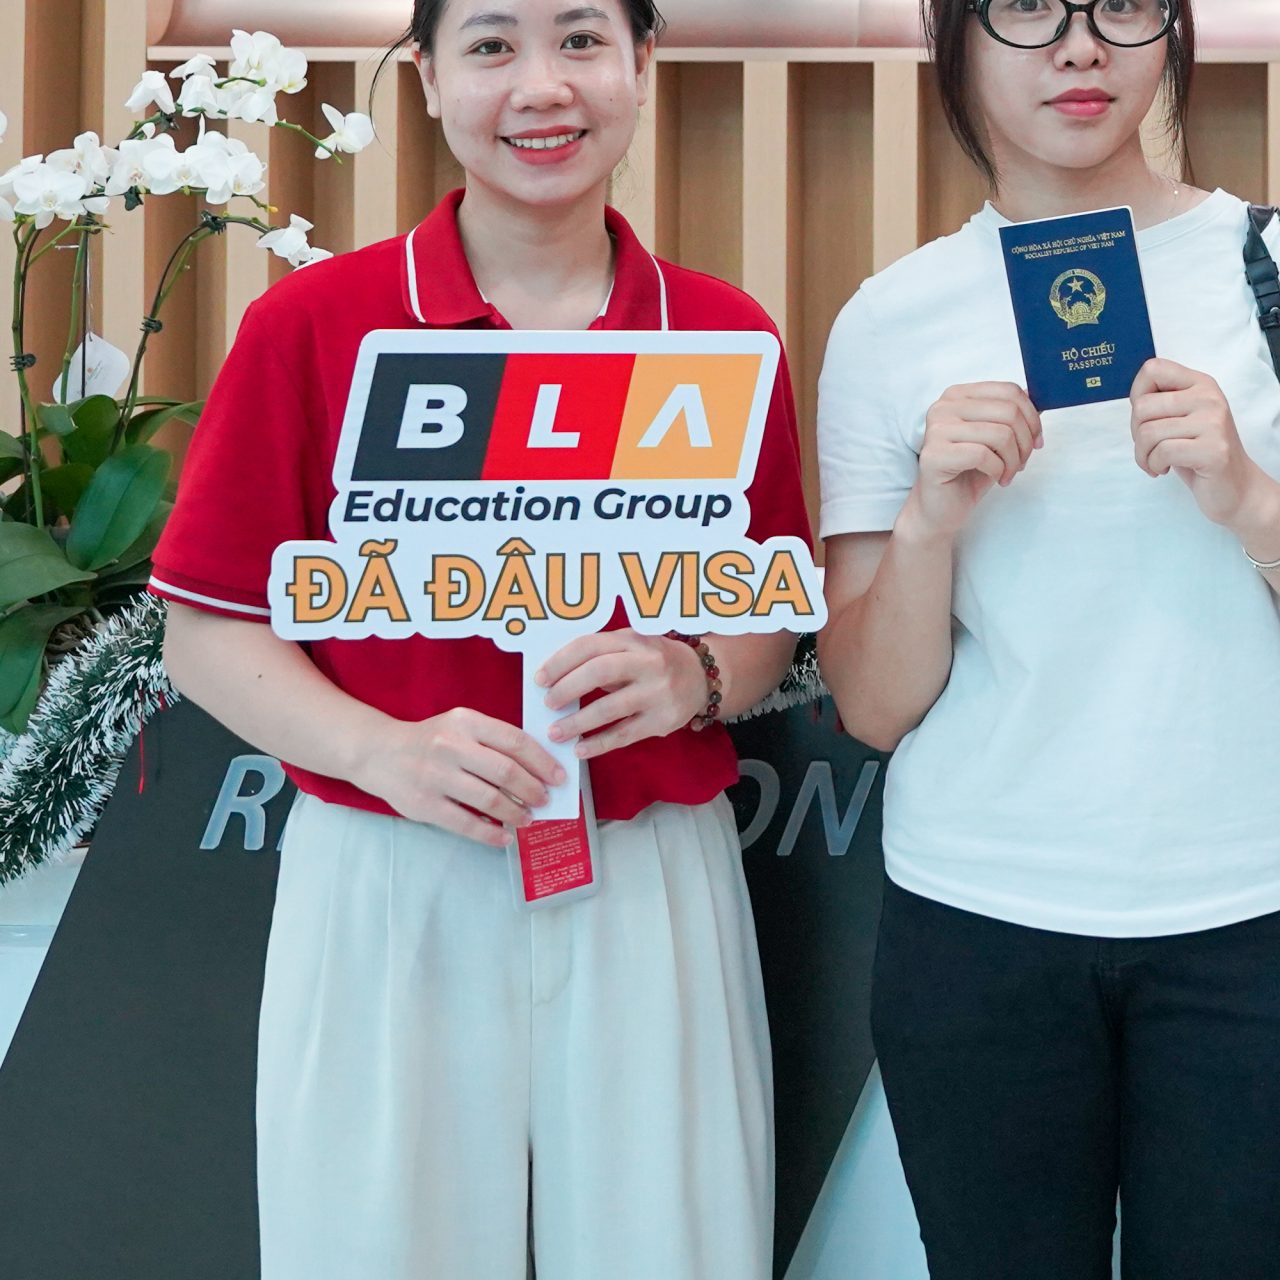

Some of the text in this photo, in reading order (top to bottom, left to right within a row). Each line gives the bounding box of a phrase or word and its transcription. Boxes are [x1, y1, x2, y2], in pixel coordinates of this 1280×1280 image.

[1111, 230, 1126, 239] NAM
[1061, 340, 1115, 361] HỘ CHIẾU
[1068, 356, 1113, 371] PASSPORT
[396, 384, 713, 449] BLA
[343, 487, 732, 526] Education Group
[285, 537, 815, 636] ĐÃ ĐẬU VISA
